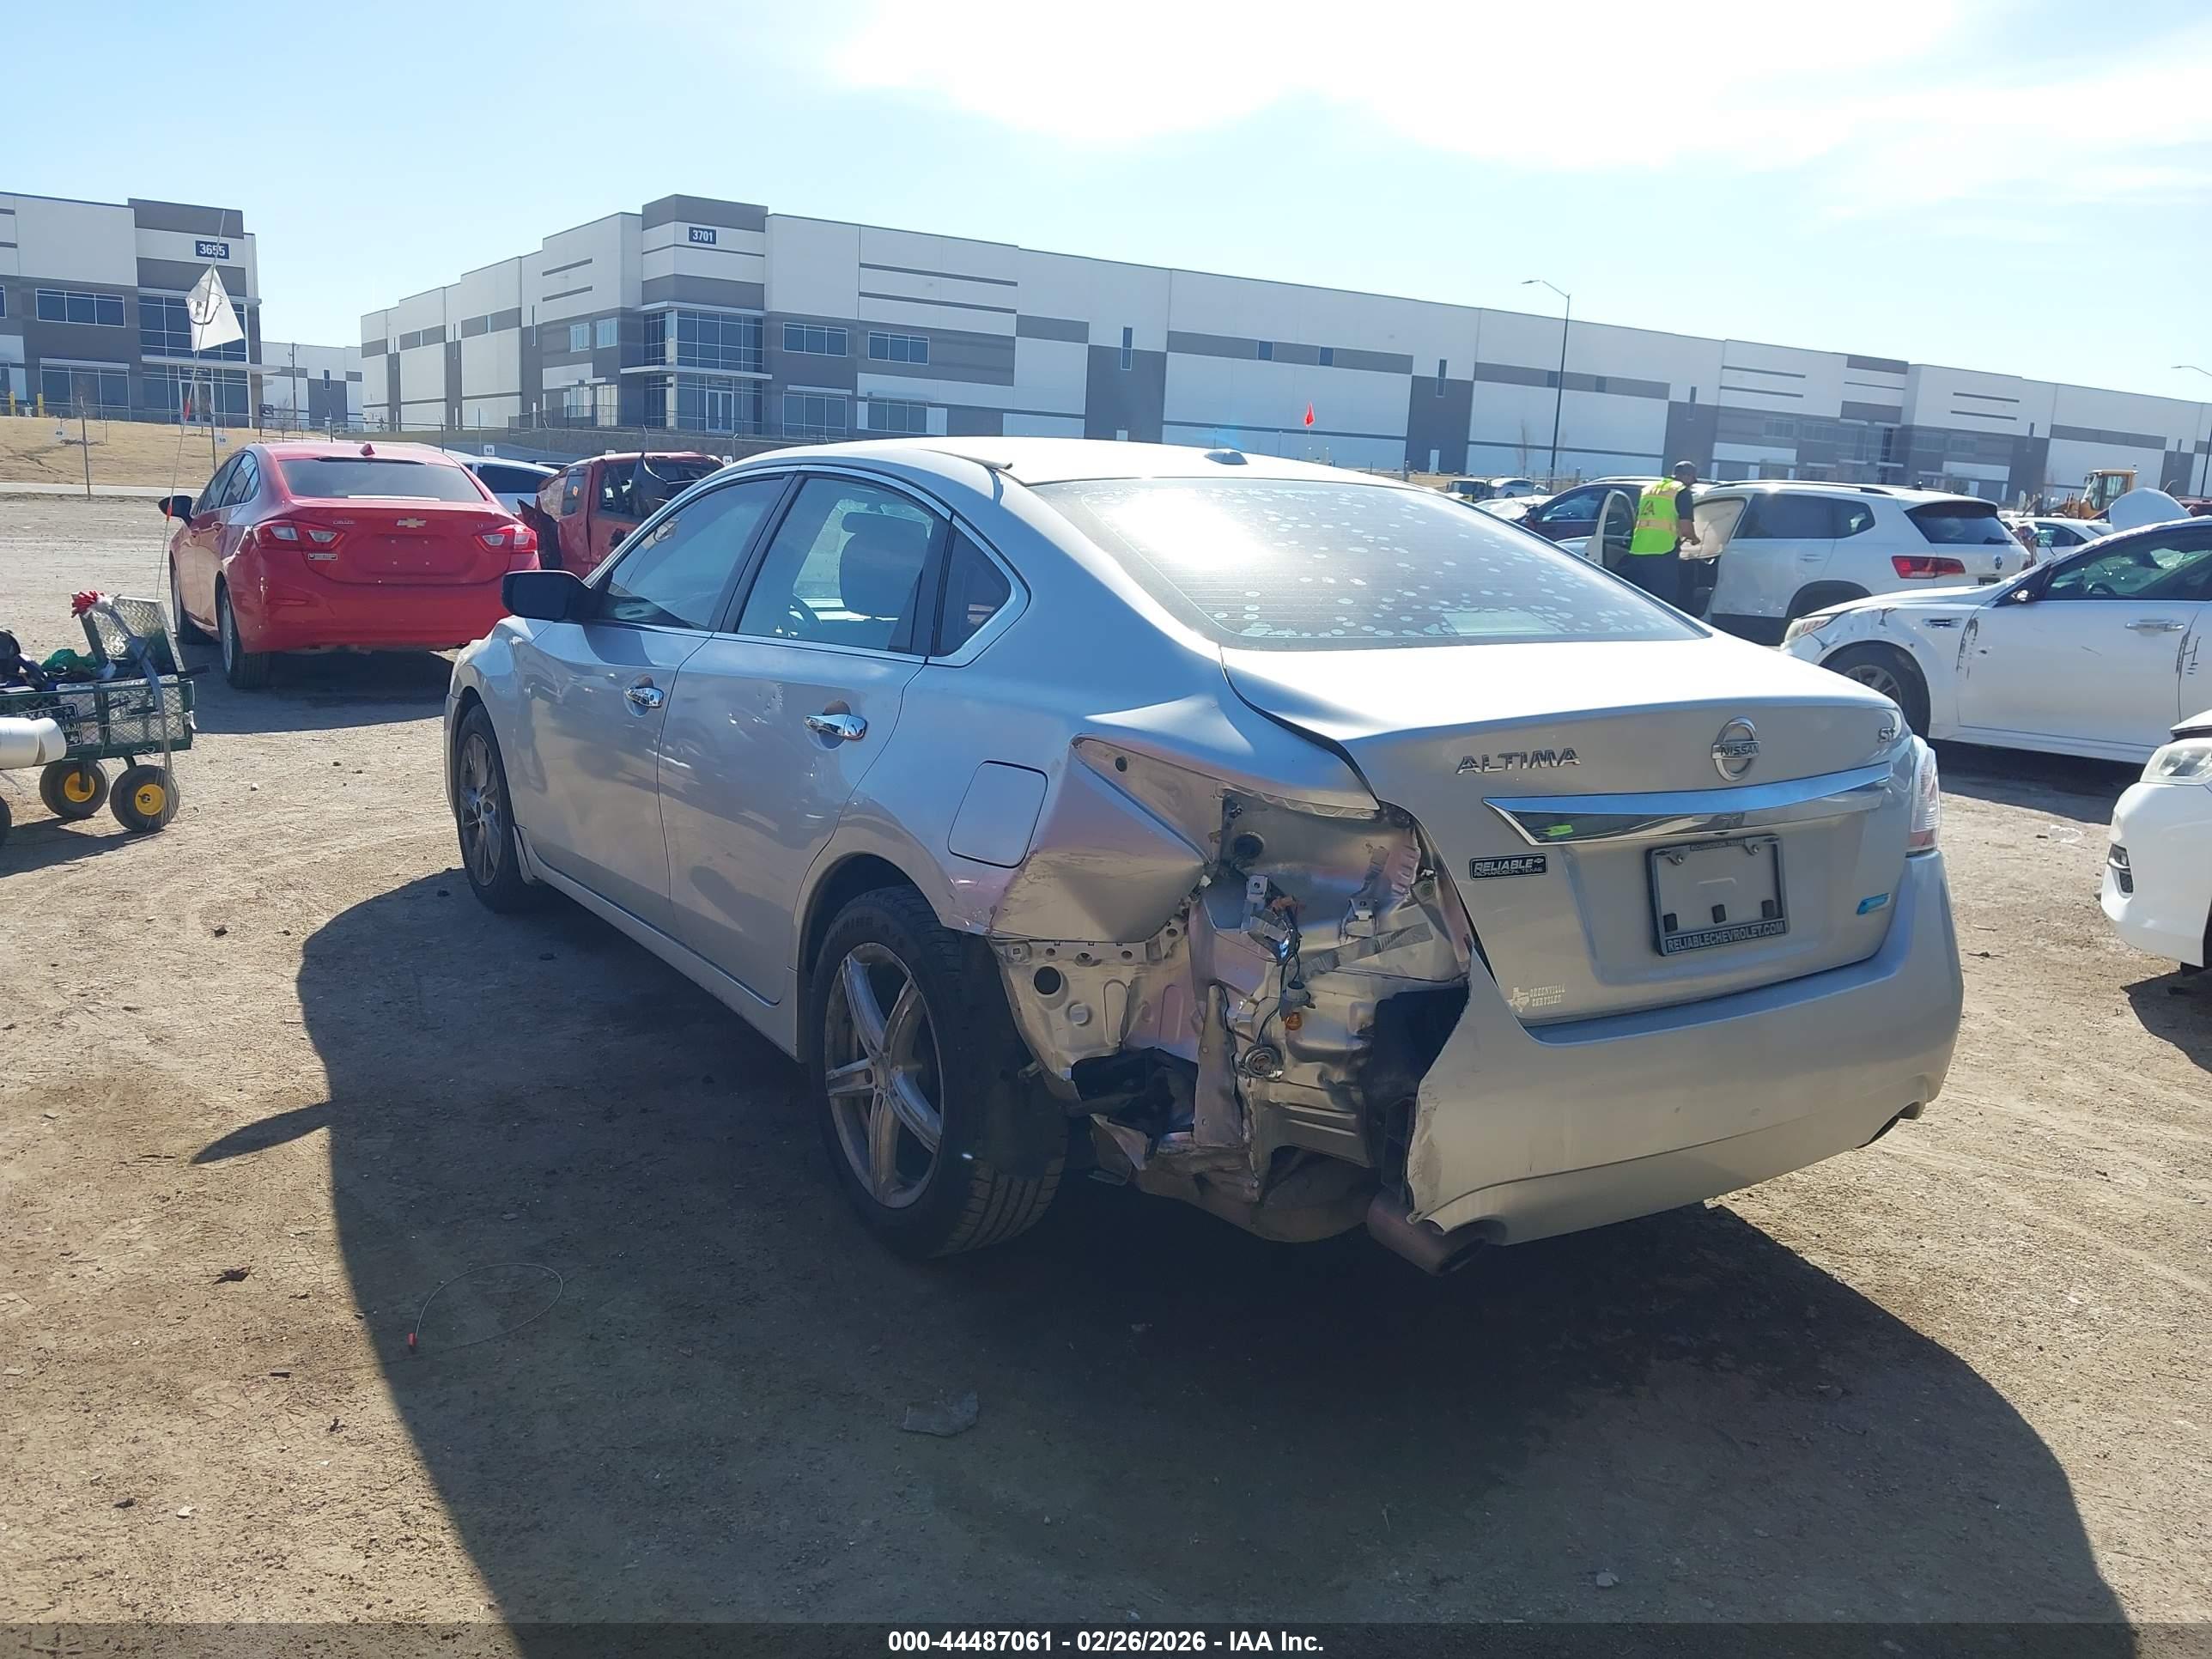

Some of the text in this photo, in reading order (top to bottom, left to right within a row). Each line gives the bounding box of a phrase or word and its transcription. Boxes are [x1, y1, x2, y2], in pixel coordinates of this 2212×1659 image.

[692, 229, 714, 242] 3701
[199, 243, 226, 257] 3655
[1720, 744, 1759, 757] NISSAN
[1455, 747, 1581, 775] ALTIMA
[1474, 858, 1534, 873] RELIABLE
[1666, 921, 1785, 953] RELIABLECHEVROLET.COM
